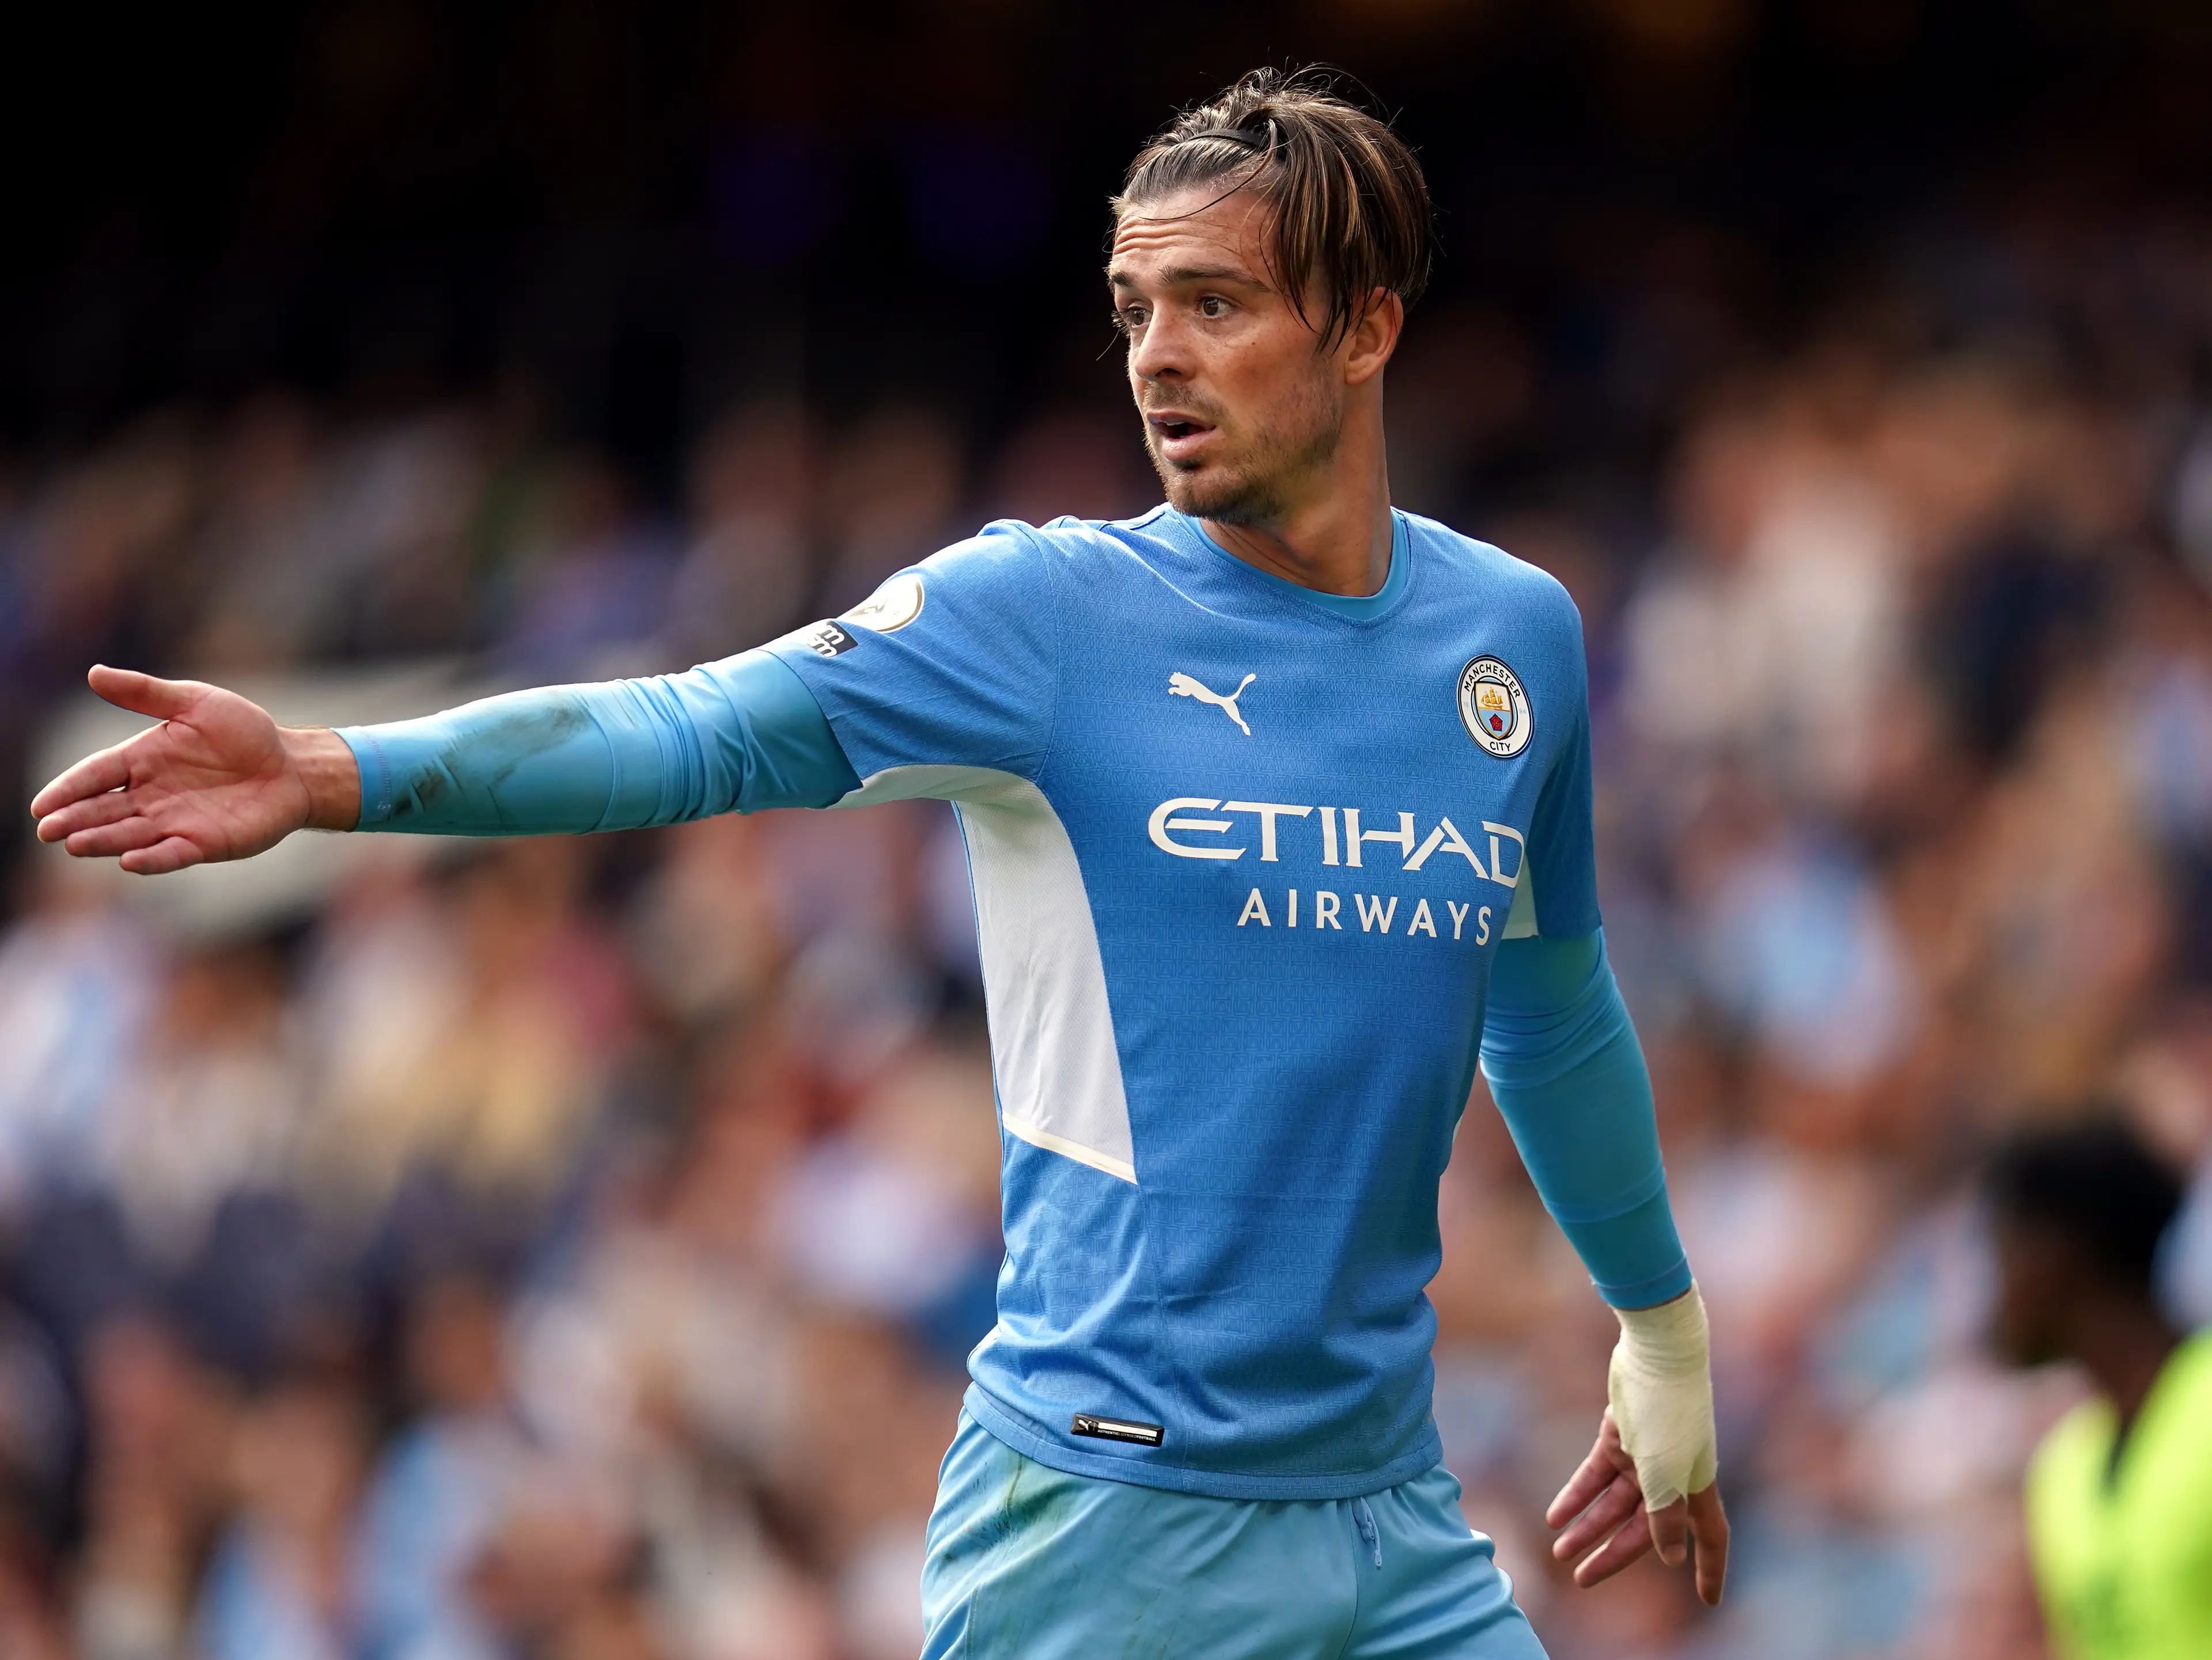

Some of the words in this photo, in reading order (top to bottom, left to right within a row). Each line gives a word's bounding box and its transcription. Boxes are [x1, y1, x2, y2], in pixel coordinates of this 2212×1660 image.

[1464, 664, 1521, 698] MANCHESTER
[1490, 741, 1510, 752] CITY
[1148, 797, 1525, 888] ETIHAD
[1237, 888, 1492, 946] AIRWAYS
